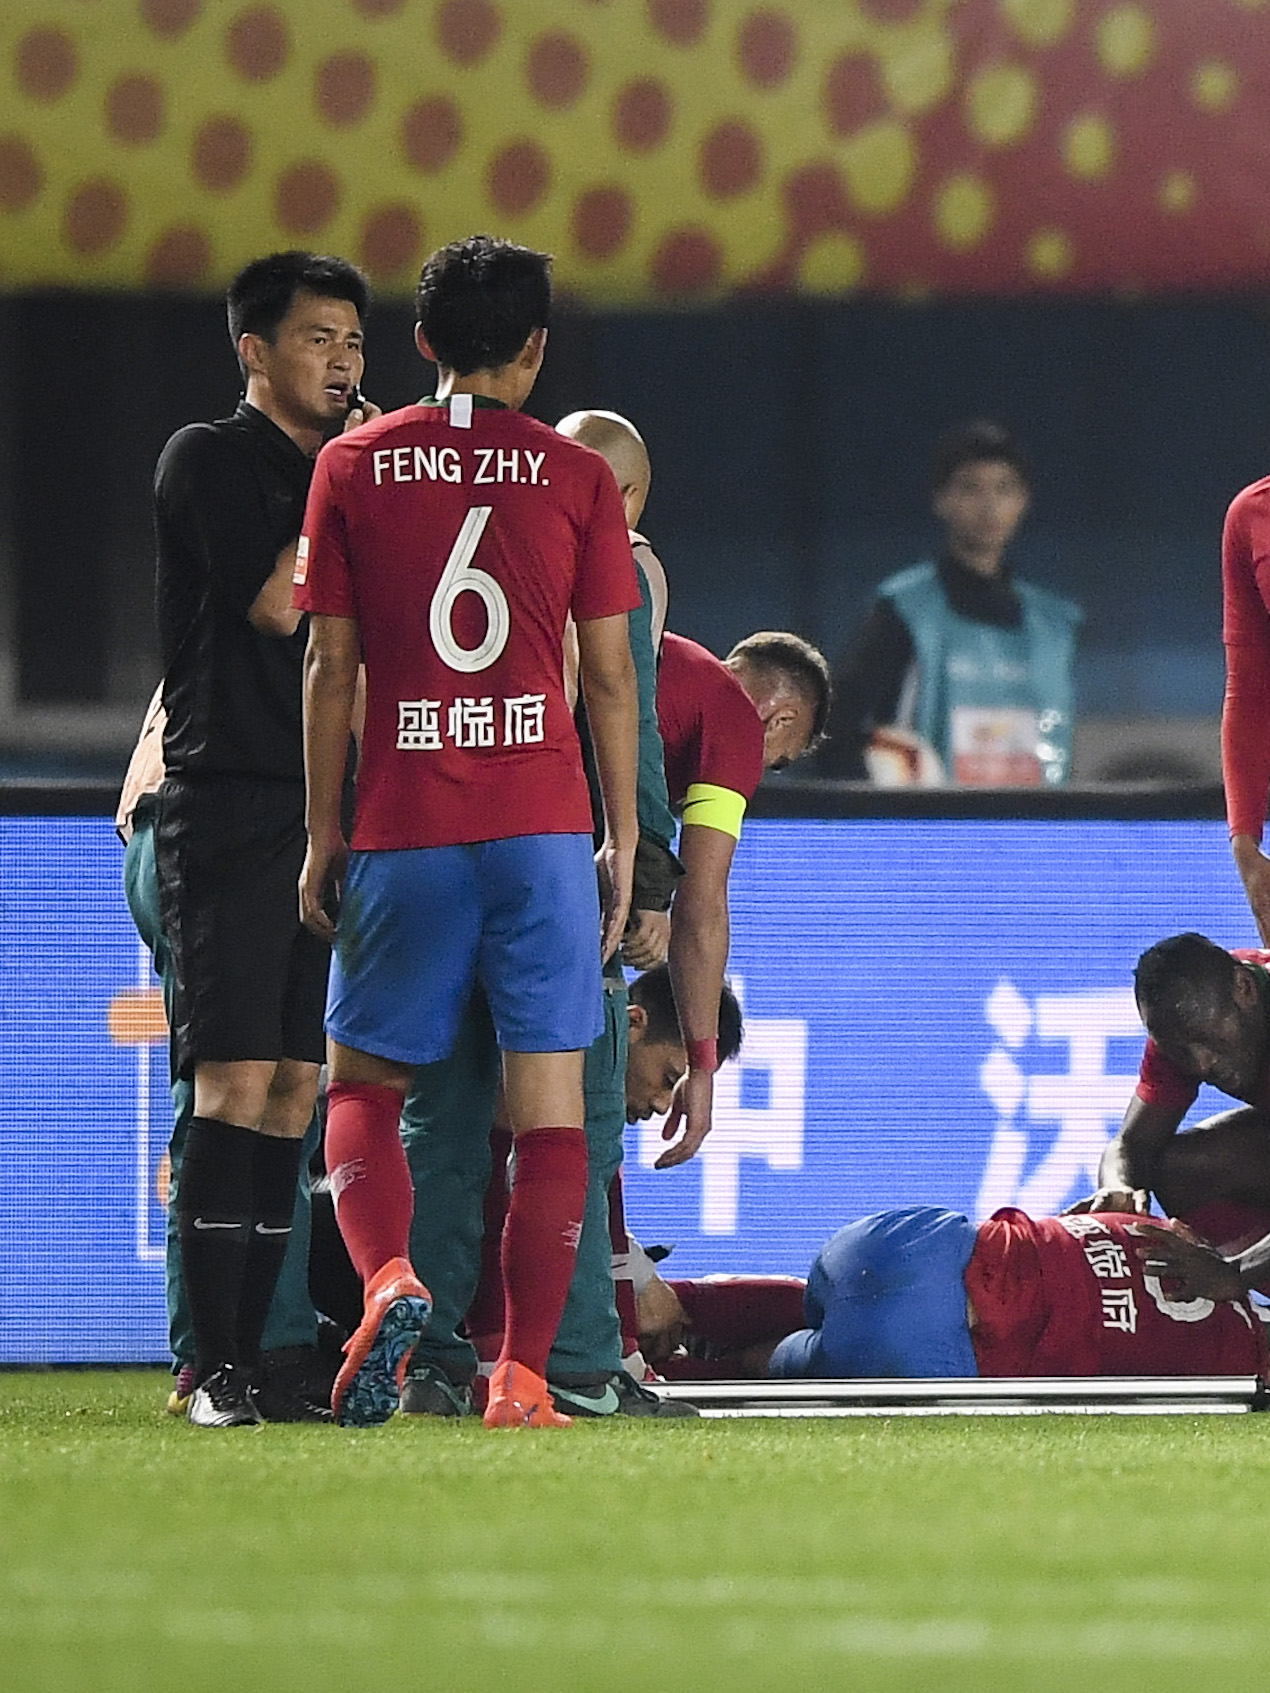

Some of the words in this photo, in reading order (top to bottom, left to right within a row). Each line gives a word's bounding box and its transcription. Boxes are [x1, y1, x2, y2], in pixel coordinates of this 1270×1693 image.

[373, 447, 462, 485] FENG
[473, 448, 550, 486] ZH.Y.
[429, 506, 510, 673] 6
[396, 694, 547, 750] 盛悦府
